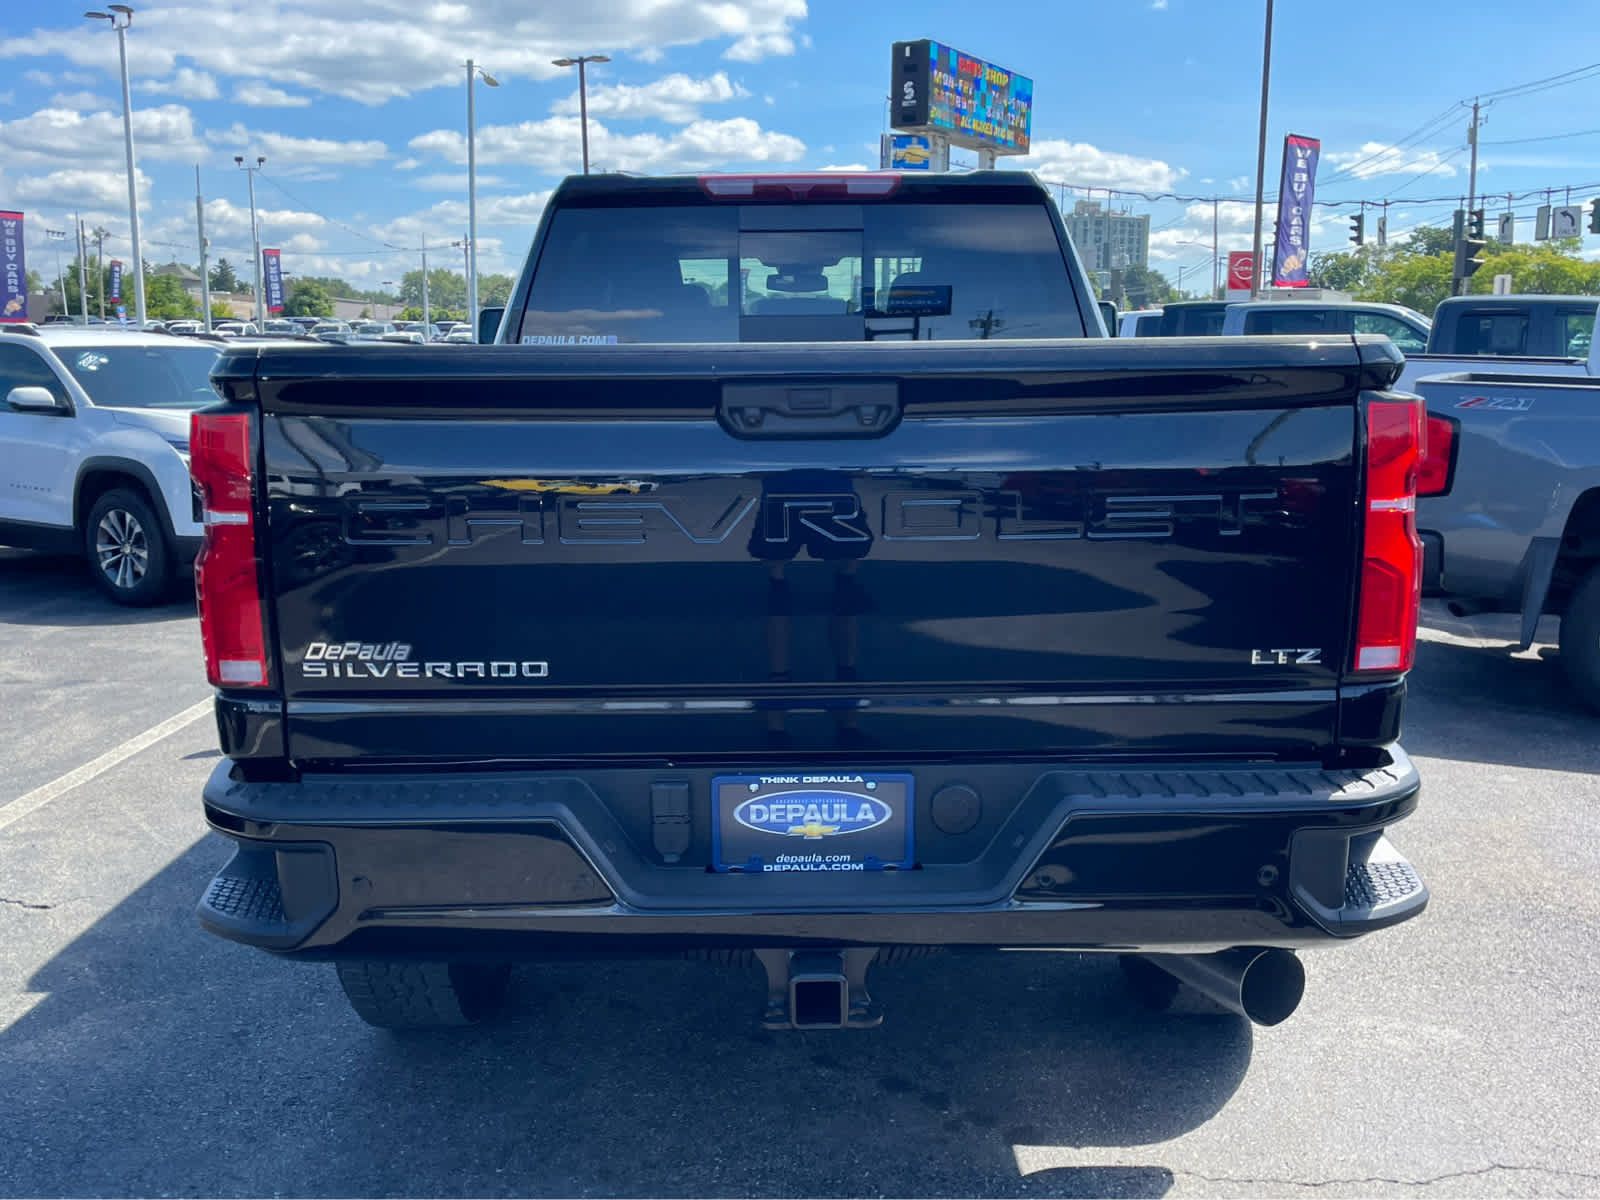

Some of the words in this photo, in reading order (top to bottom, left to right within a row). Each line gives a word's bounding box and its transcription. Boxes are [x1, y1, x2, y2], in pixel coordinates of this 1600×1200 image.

[1295, 147, 1312, 169] WE
[1293, 172, 1308, 201] BUY
[2, 220, 17, 236] WE
[6, 238, 17, 262] BUY
[343, 489, 1280, 546] CHEVROLET
[304, 641, 412, 661] DePaula
[1251, 648, 1322, 665] LTZ
[302, 661, 549, 678] SILVERADO
[759, 776, 799, 784] THINK
[802, 775, 864, 784] DEPAULA
[749, 803, 877, 823] DEPAULA
[775, 853, 851, 863] depaula.com
[763, 863, 864, 872] DEPAULA.COM
